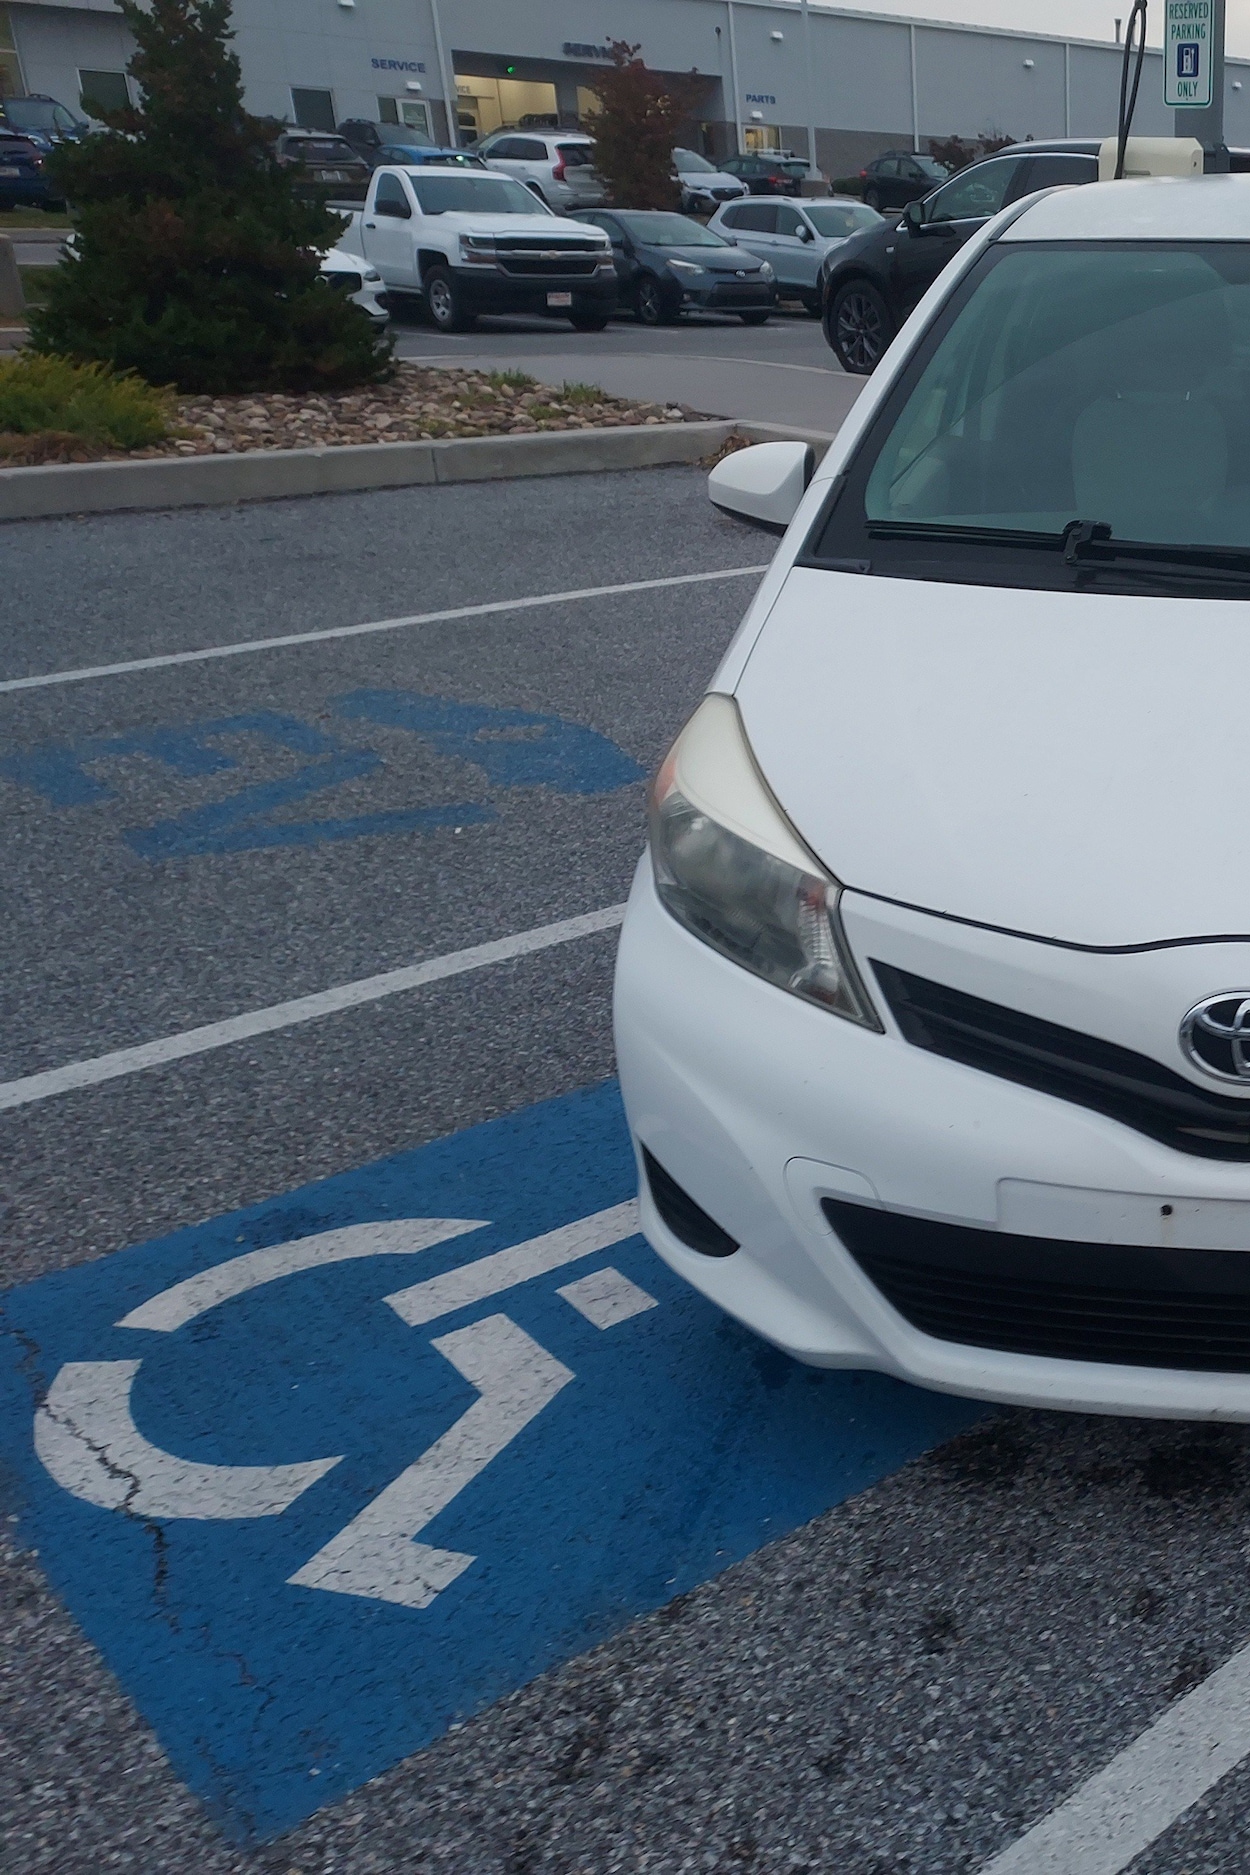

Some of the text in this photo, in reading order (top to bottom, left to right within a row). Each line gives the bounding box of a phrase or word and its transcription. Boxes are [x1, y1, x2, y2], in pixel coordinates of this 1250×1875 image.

[1169, 2, 1209, 19] RESERVED
[1171, 23, 1206, 40] PARKING
[371, 58, 426, 73] SERVICE
[1177, 81, 1198, 97] ONLY
[745, 93, 776, 105] PARTS
